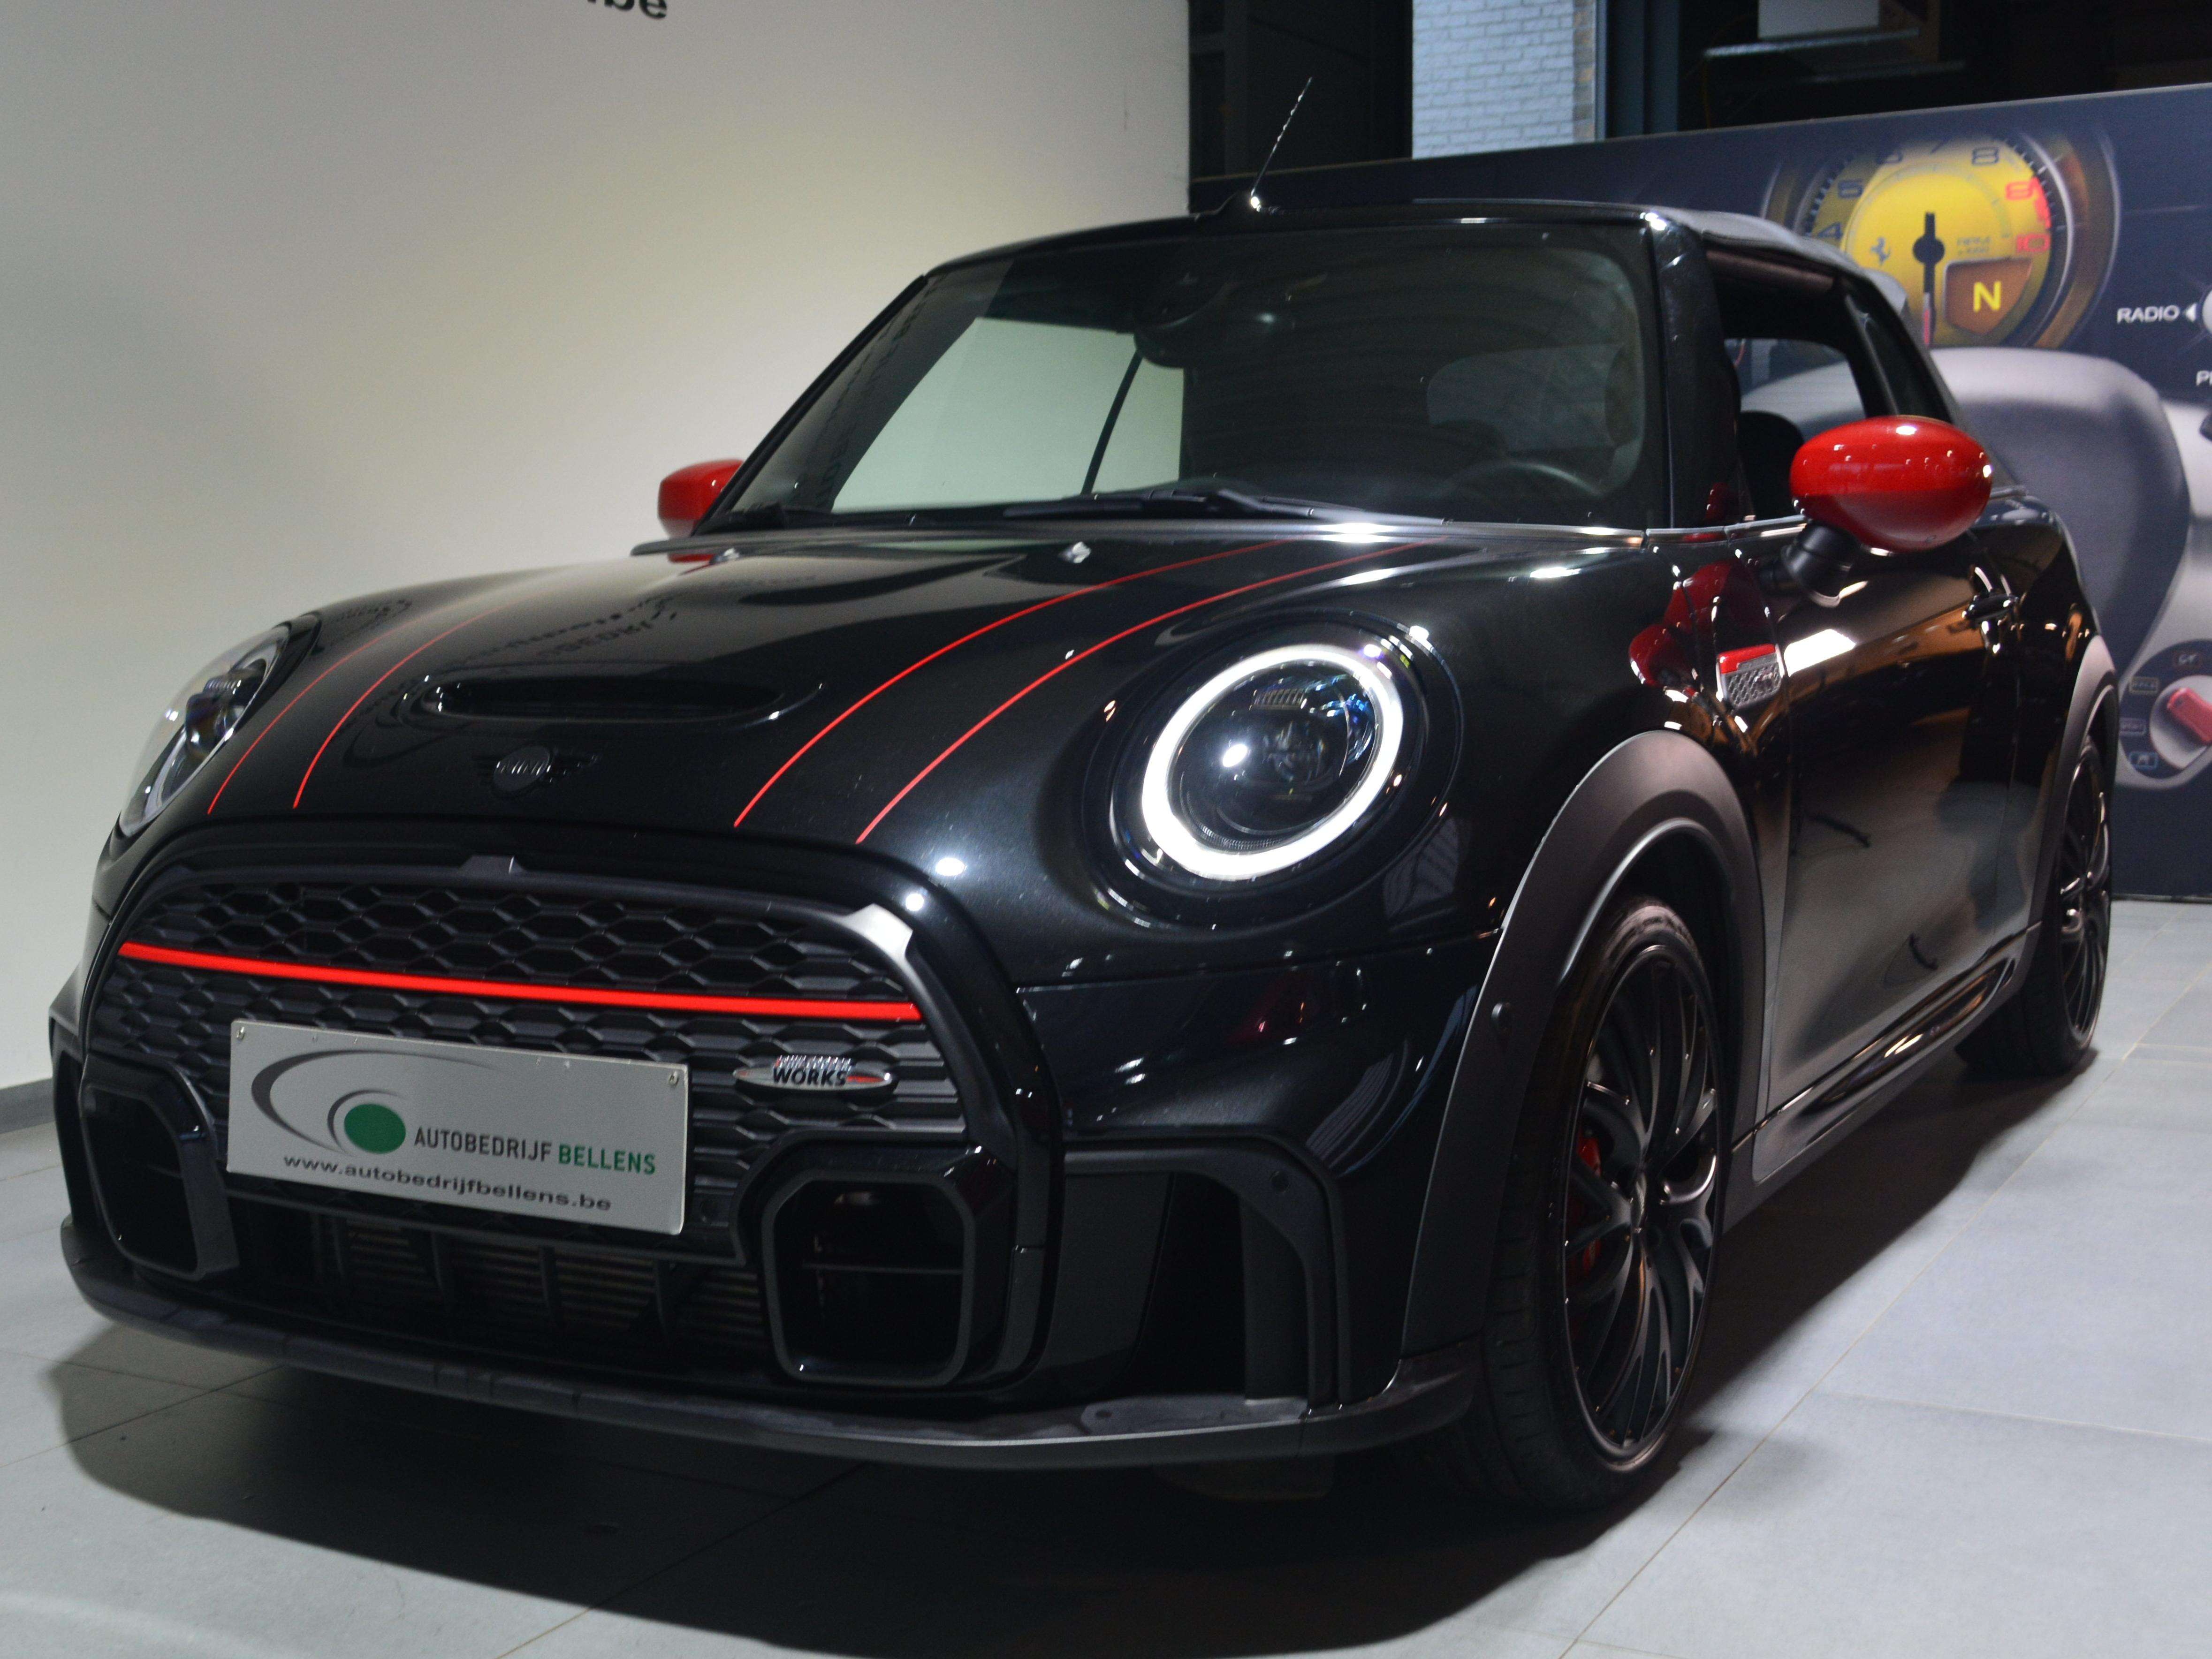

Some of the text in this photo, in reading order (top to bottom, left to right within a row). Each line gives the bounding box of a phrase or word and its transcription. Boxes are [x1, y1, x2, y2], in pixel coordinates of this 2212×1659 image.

[1972, 146, 1999, 165] 8
[1818, 222, 1842, 240] 4
[2016, 233, 2051, 253] 10
[1973, 280, 2001, 313] N
[2116, 304, 2180, 324] RADIO
[773, 1067, 847, 1086] WORKS
[414, 1126, 656, 1175] AUTOBEDRIJF BELLENS
[283, 1154, 612, 1212] www.autobedrijfbellens.be
